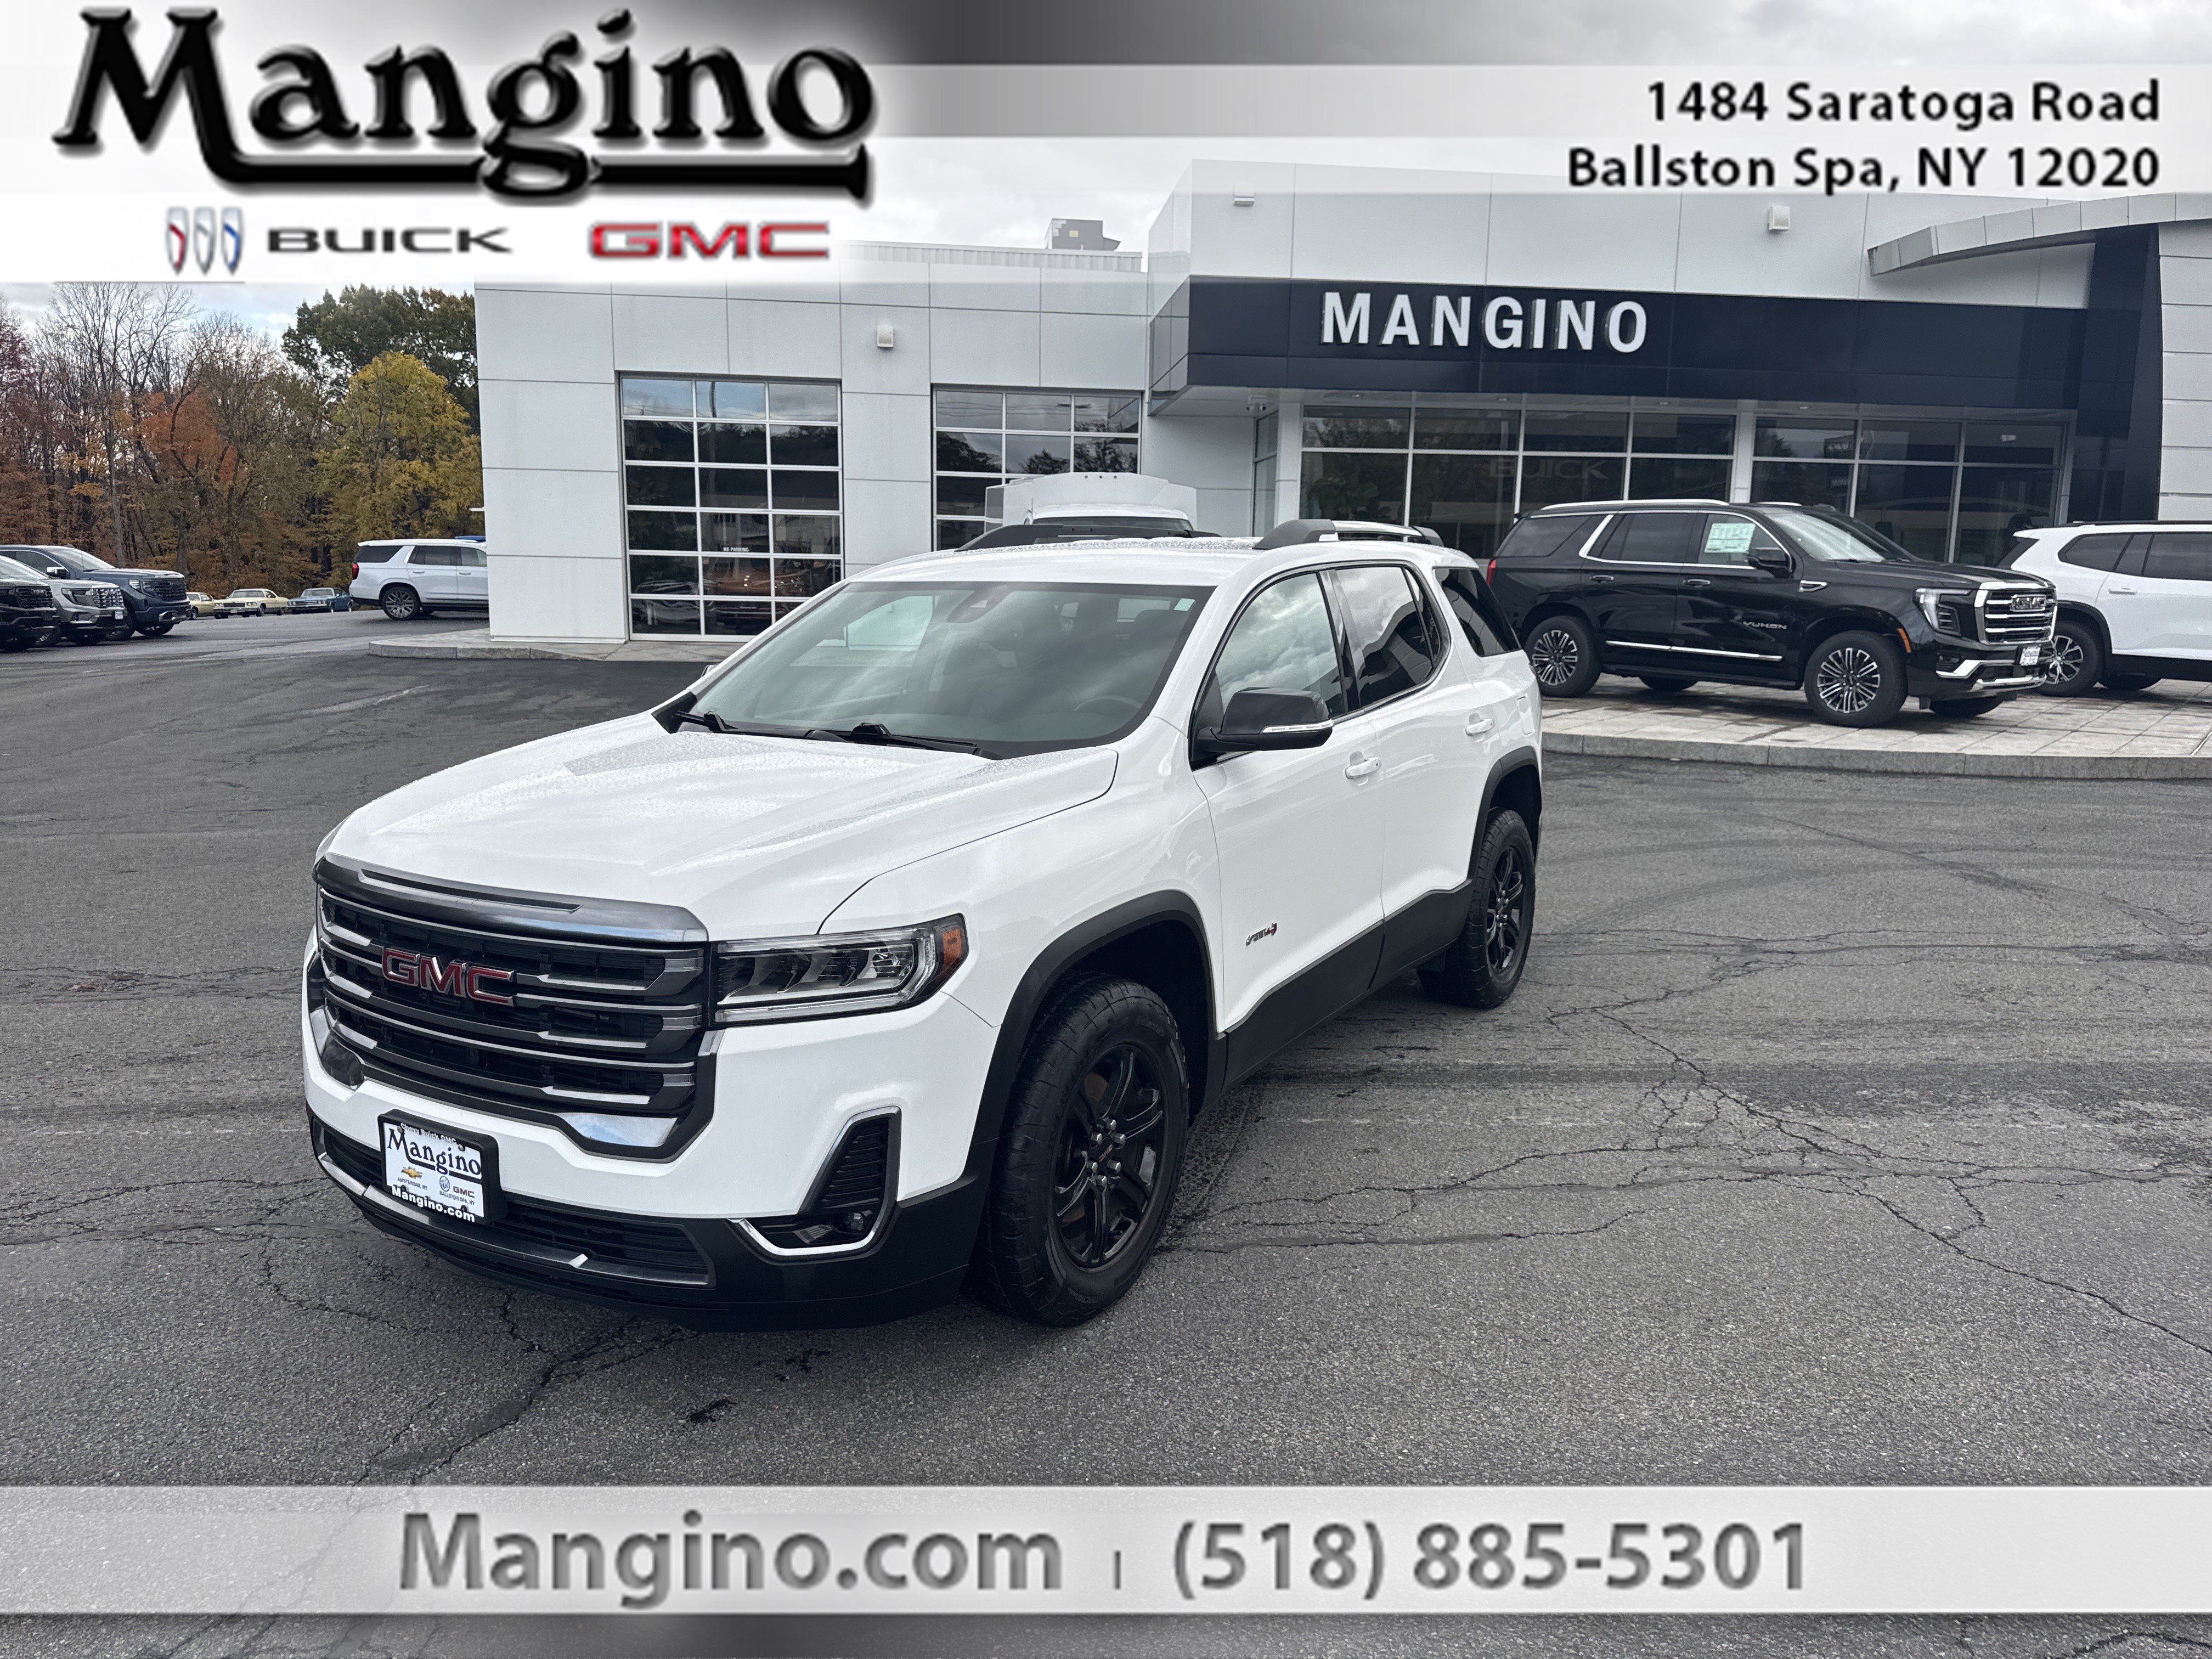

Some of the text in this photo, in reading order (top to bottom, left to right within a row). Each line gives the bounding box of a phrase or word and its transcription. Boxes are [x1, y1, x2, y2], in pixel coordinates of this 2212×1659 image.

[1320, 291, 1647, 353] MANGINO
[1743, 621, 1787, 630] YUKON
[382, 947, 515, 1007] GMC
[387, 1128, 481, 1176] Mangino
[392, 1186, 475, 1222] Mangino.com
[453, 1186, 475, 1198] GMC
